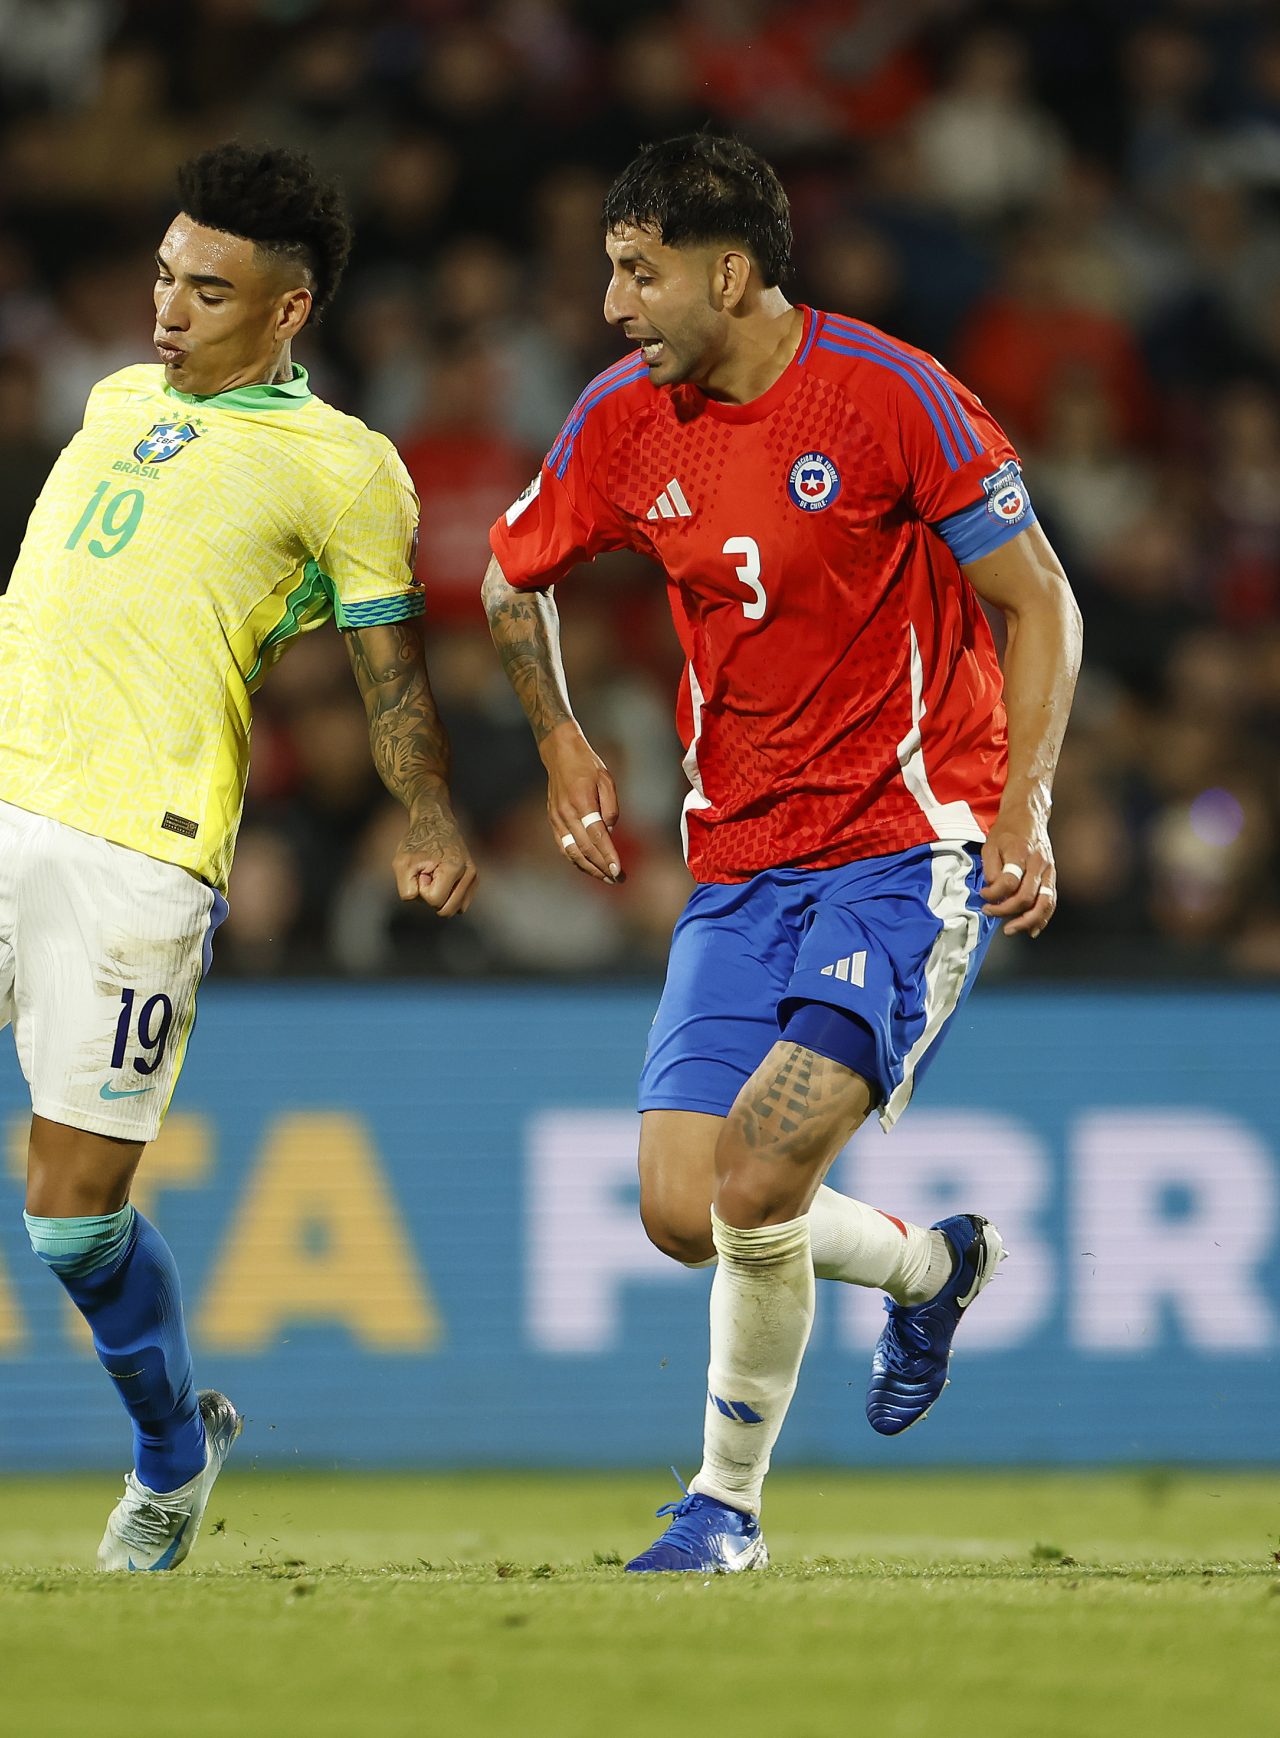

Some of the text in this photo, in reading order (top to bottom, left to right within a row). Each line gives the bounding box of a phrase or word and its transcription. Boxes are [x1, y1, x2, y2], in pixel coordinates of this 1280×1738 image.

[111, 460, 161, 480] BRASIL
[155, 435, 176, 446] CBF
[64, 480, 145, 559] 19
[722, 536, 767, 620] 3
[110, 987, 173, 1075] 19
[523, 1106, 1277, 1357] FBR
